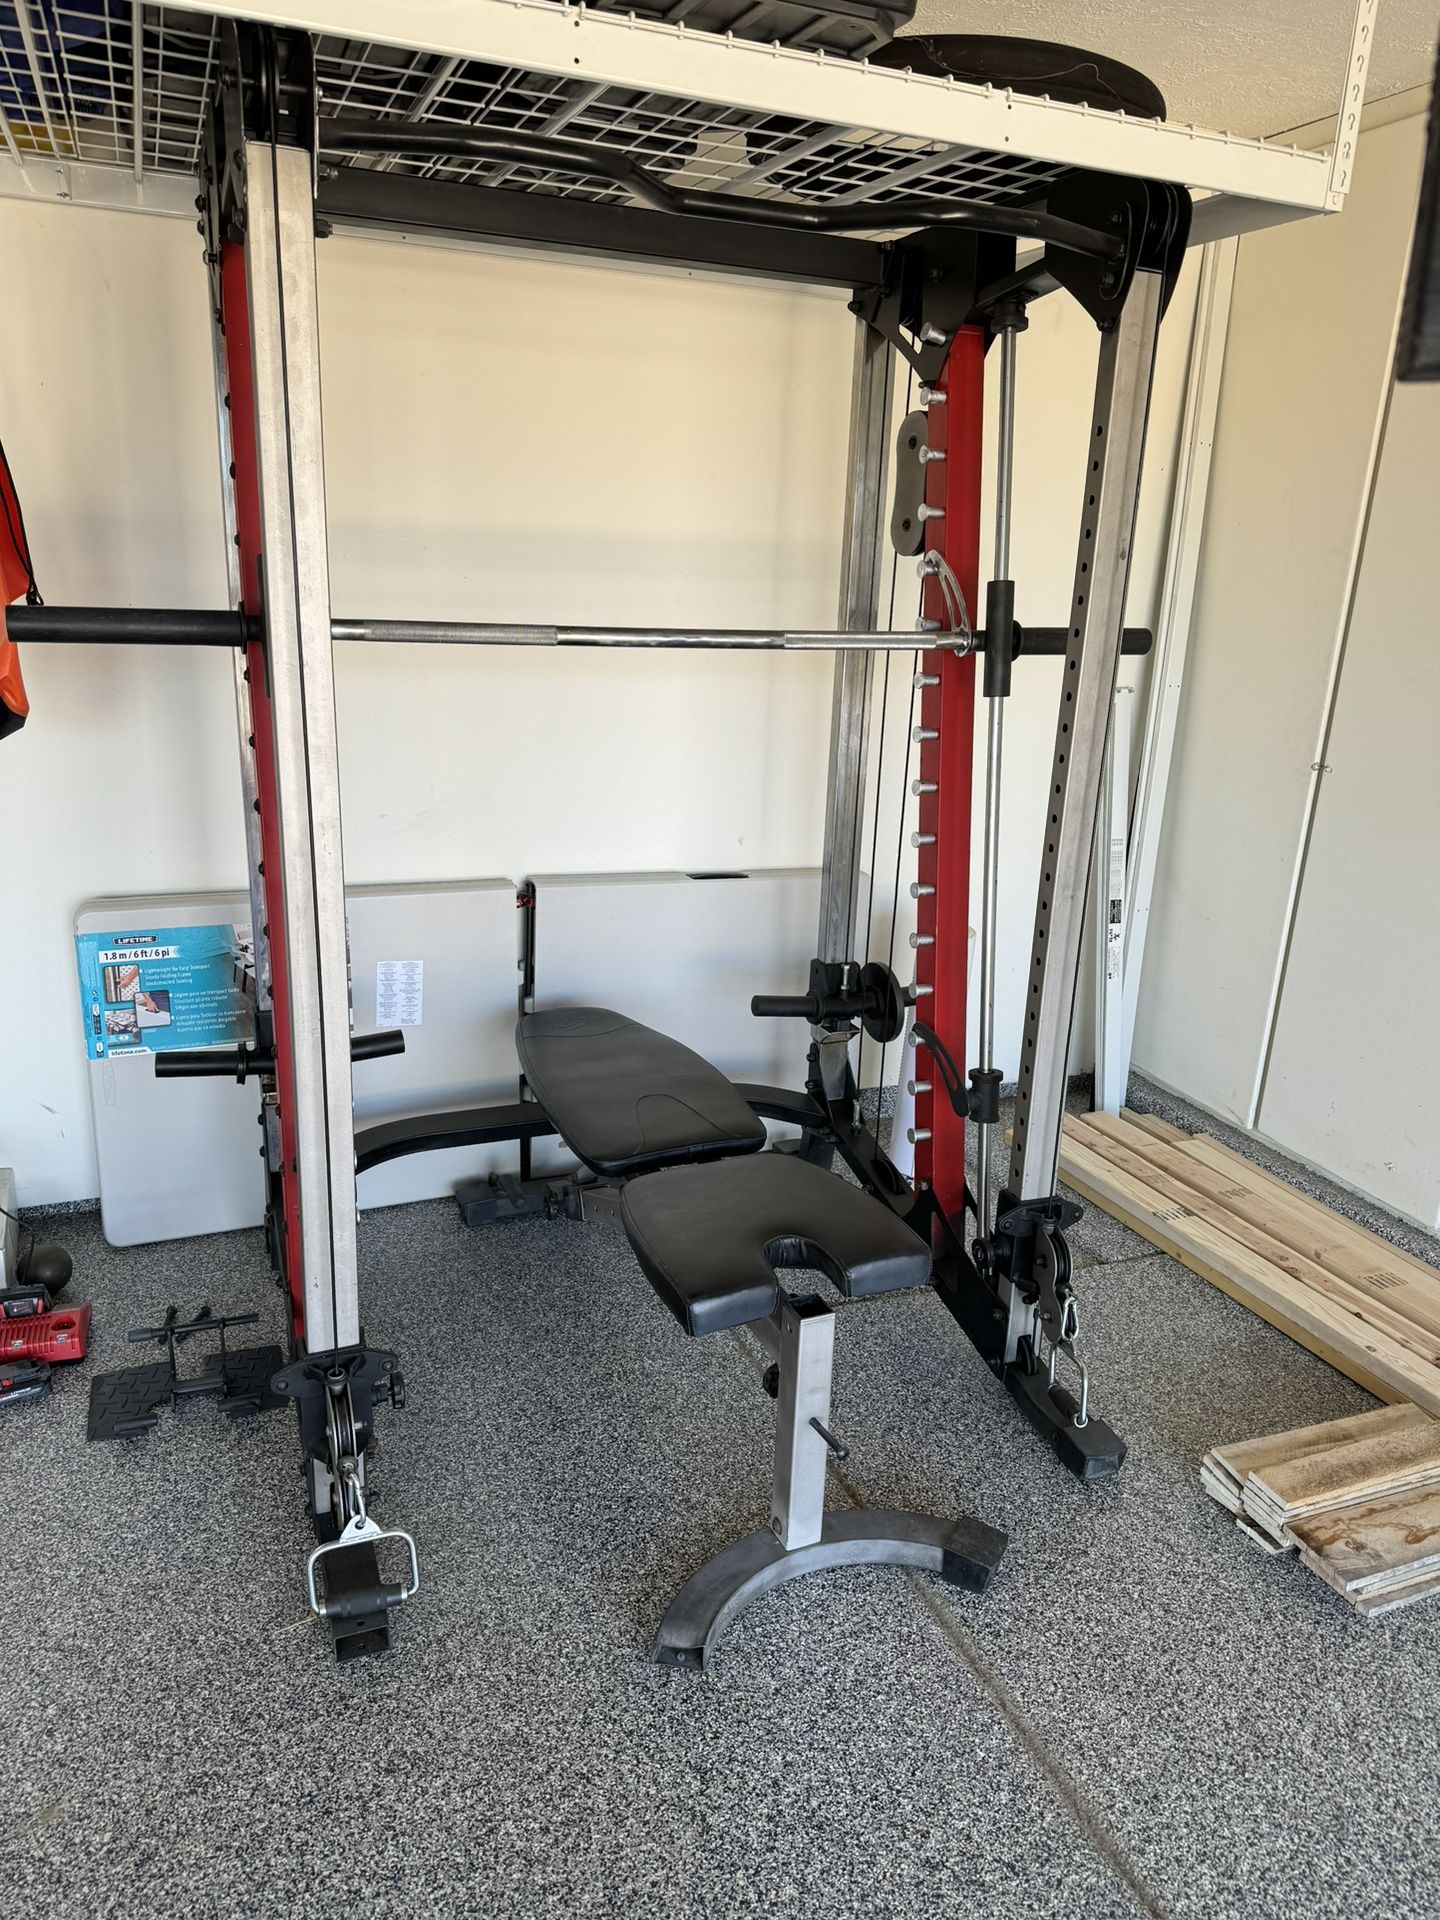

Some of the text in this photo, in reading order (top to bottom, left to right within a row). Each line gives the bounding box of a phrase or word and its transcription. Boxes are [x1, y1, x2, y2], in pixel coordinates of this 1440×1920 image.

[118, 936, 153, 944] LIFETIME
[104, 952, 117, 960] 1.8
[161, 948, 169, 957] pi
